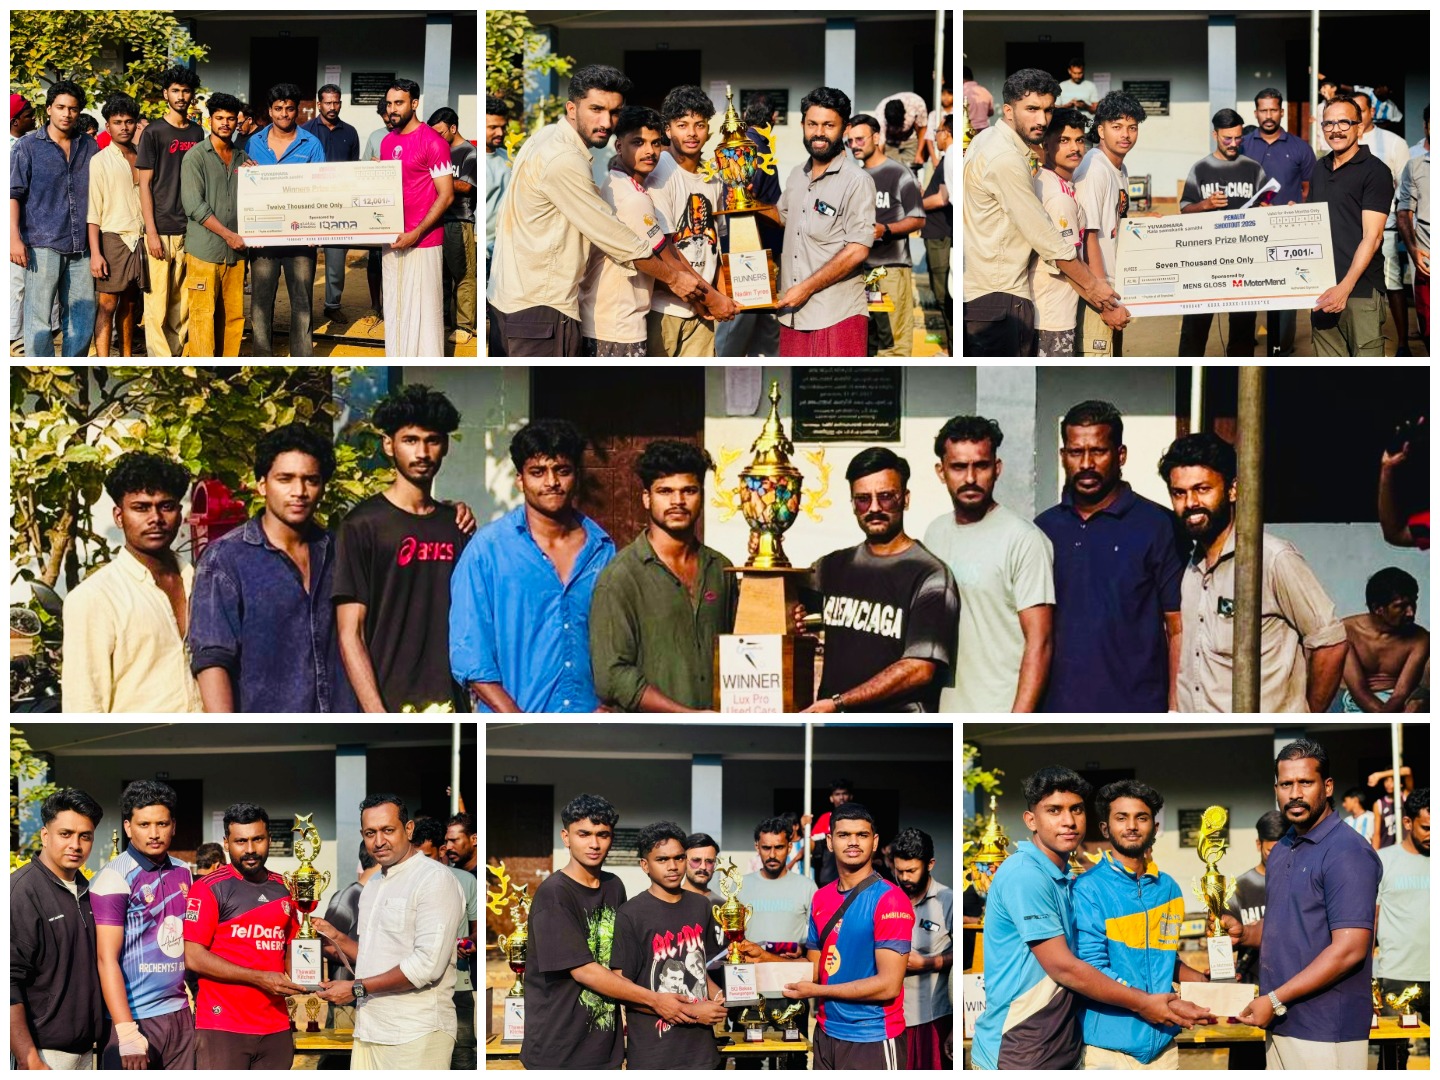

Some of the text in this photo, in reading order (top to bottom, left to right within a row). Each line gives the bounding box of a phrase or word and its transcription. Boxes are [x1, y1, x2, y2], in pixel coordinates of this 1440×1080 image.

[1214, 221, 1240, 229] SHOOTOUT
[1175, 234, 1269, 248] Runners Prize Money
[1283, 248, 1314, 259] 7,001/-
[1180, 259, 1217, 267] Thousand
[1237, 256, 1254, 265] Only
[733, 273, 767, 283] RUNNERS
[418, 542, 454, 560] asics
[823, 595, 903, 640] ALENCIAGA
[722, 673, 780, 689] WINNER
[733, 693, 769, 704] Lux Pro
